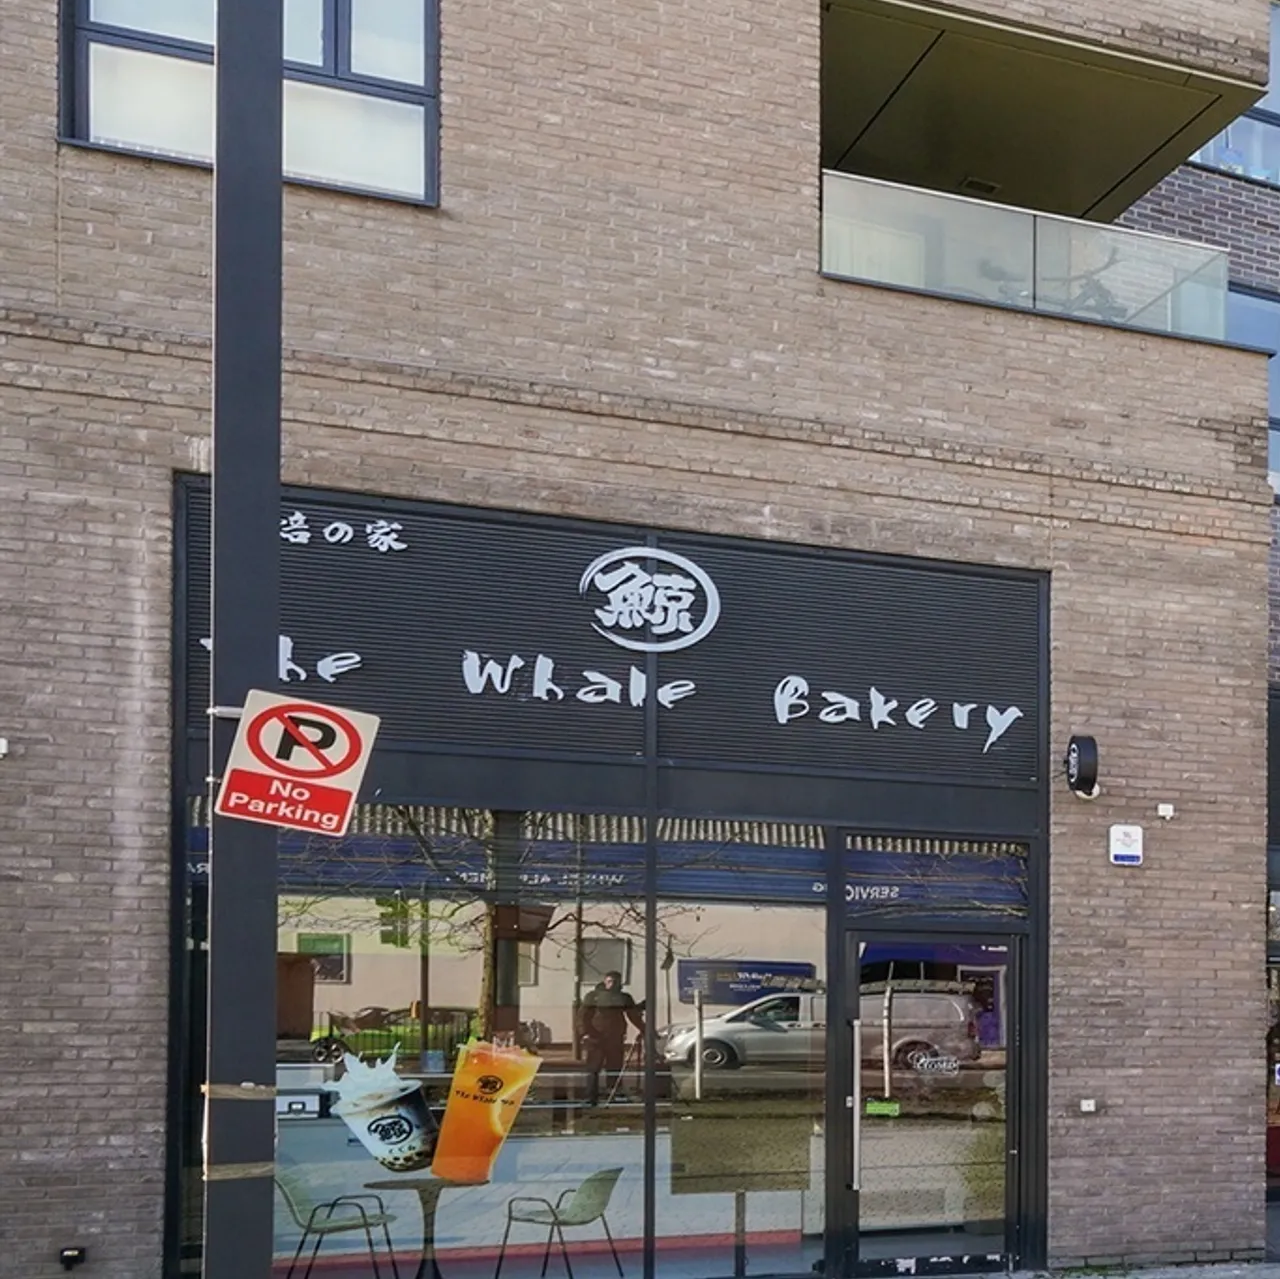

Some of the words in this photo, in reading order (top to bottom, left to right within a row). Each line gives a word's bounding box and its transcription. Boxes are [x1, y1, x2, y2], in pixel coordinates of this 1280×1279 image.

[462, 649, 697, 709] Whale
[774, 675, 1023, 754] Bakery
[269, 780, 311, 801] No
[228, 792, 340, 829] Parking
